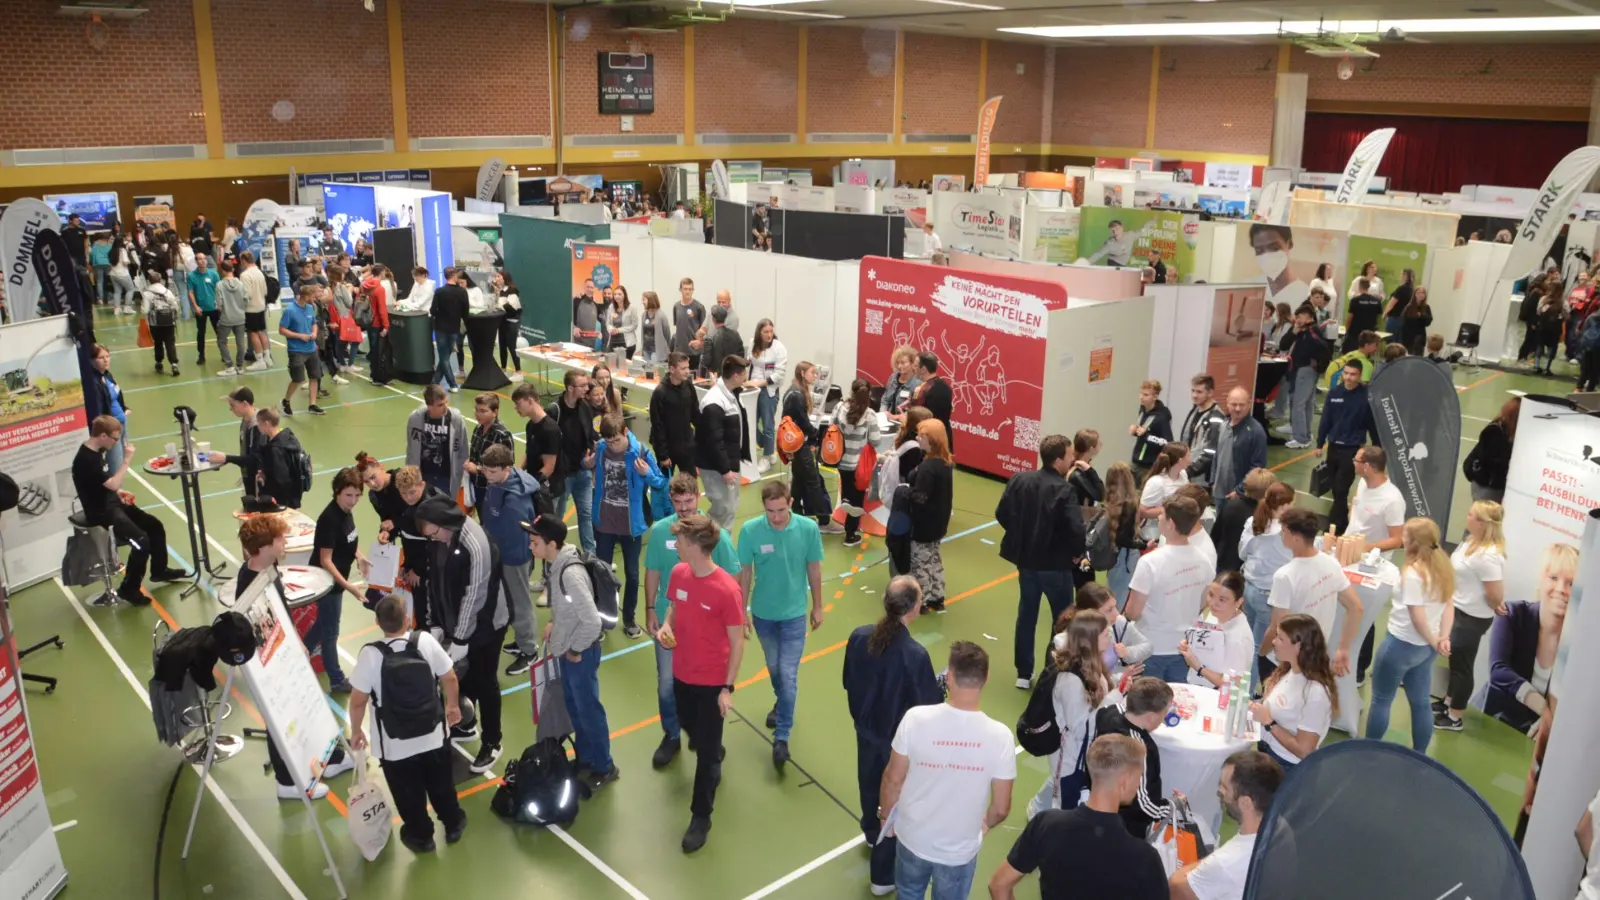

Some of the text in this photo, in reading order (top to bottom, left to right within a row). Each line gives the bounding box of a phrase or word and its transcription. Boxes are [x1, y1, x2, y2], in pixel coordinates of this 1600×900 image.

[1338, 156, 1366, 204] STARK
[1522, 180, 1564, 242] STARK
[1163, 220, 1178, 230] DER
[9, 218, 42, 286] DOMMEL
[1138, 238, 1176, 250] IN DEINE
[952, 280, 1021, 306] KEINE MACHT DEN
[963, 296, 1042, 328] VORURTEILEN
[1542, 468, 1577, 488] PASST!
[1536, 496, 1553, 510] BEI
